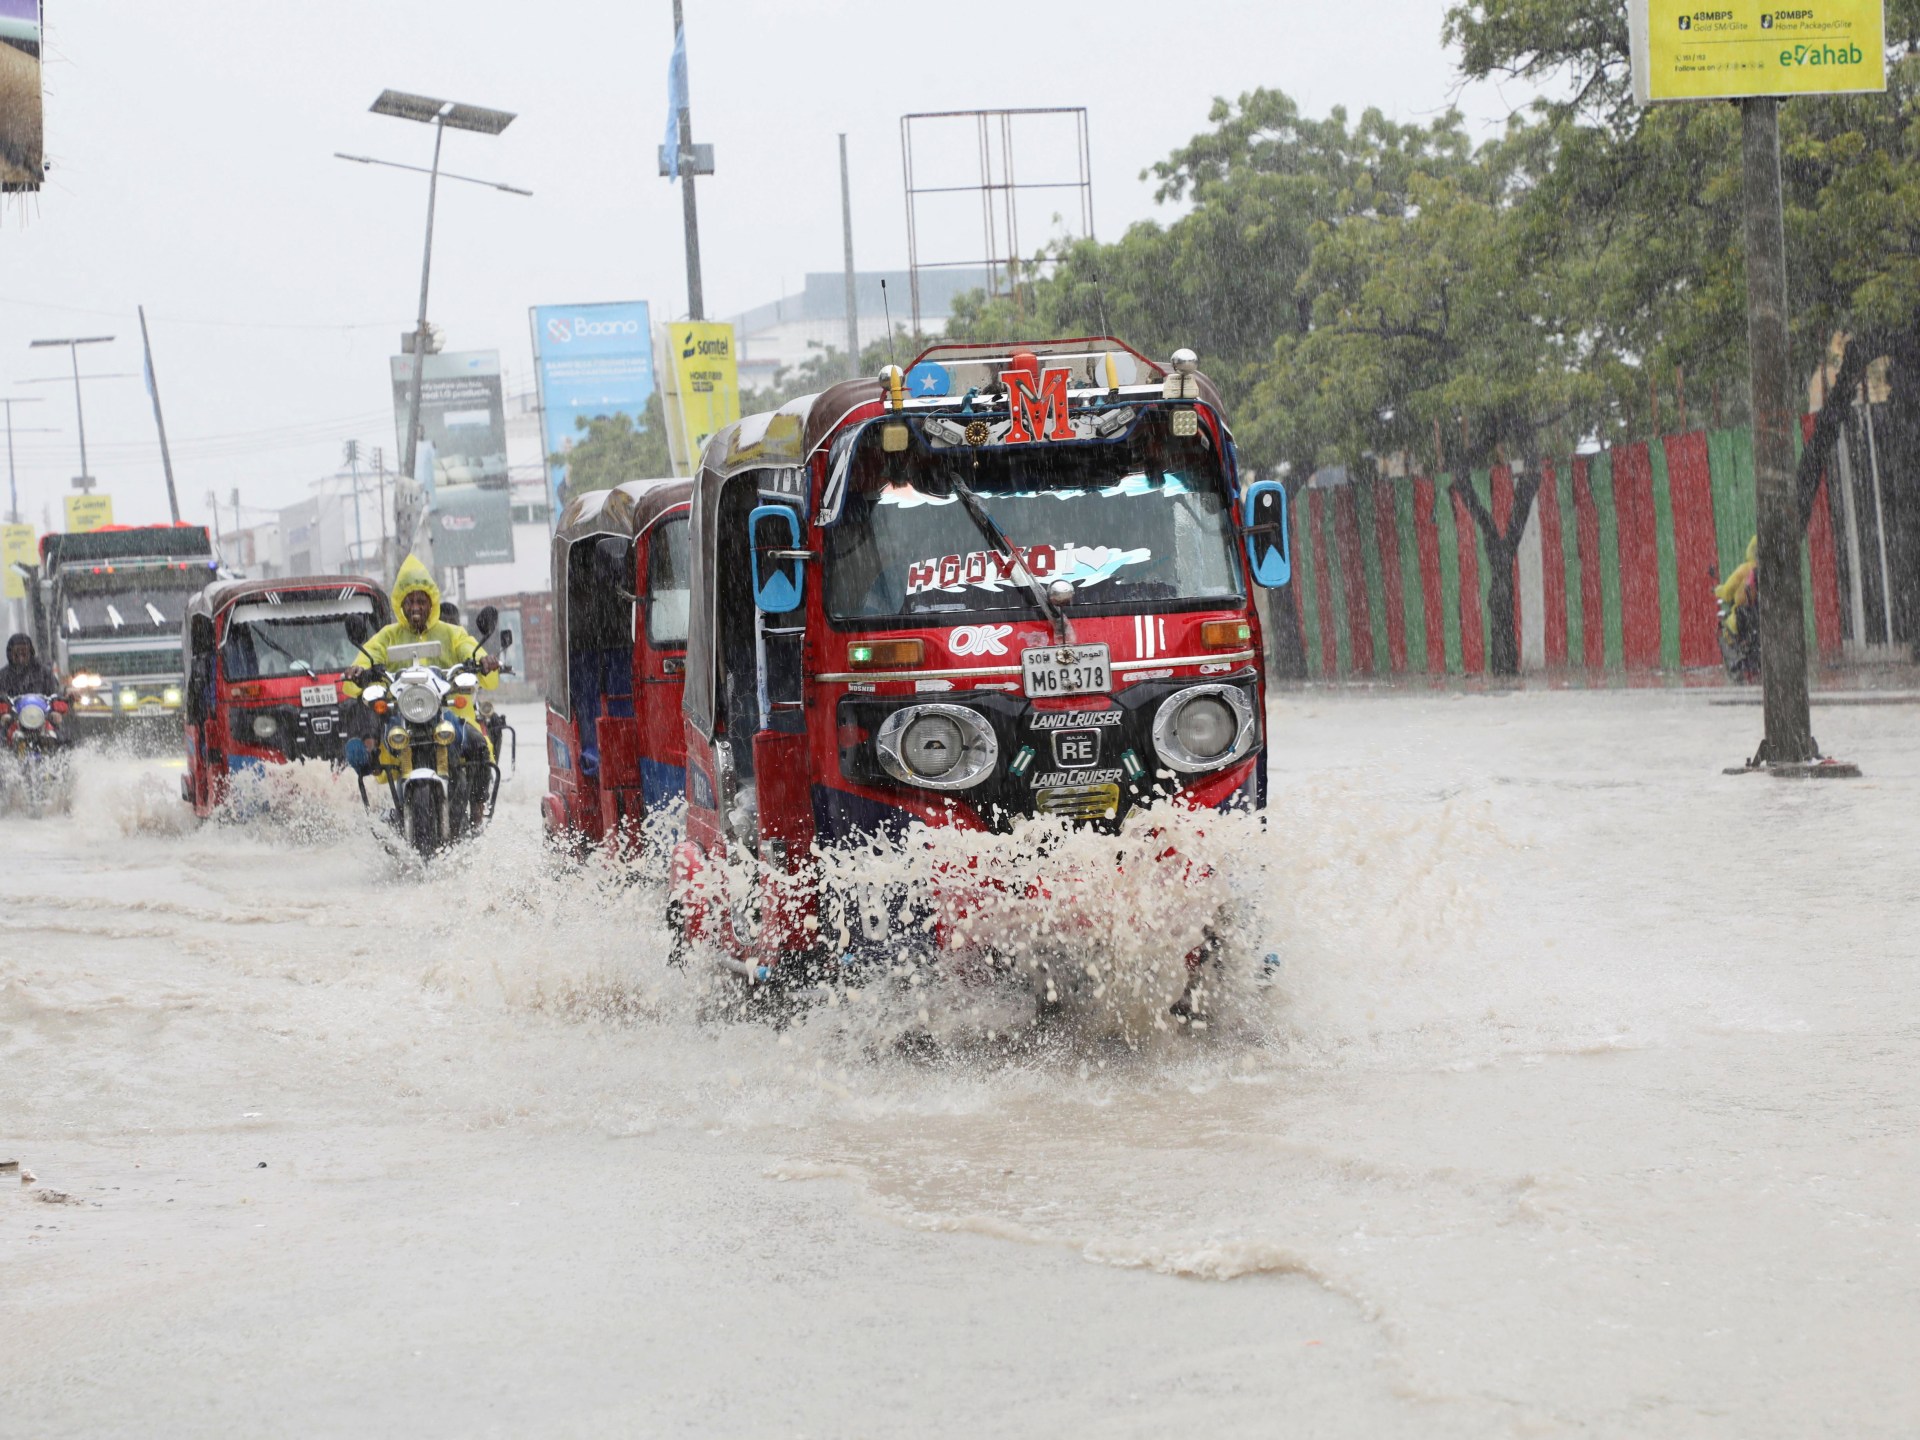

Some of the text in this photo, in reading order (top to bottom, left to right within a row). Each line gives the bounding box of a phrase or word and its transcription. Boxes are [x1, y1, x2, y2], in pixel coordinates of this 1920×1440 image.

[1775, 10, 1814, 19] 20MBPS
[1694, 23, 1712, 31] Gold
[1776, 23, 1797, 31] Home
[574, 317, 638, 336] Baano
[697, 336, 728, 355] somtel
[999, 367, 1077, 444] M
[949, 625, 1013, 656] OK
[315, 722, 329, 731] RE
[1061, 741, 1093, 760] RE
